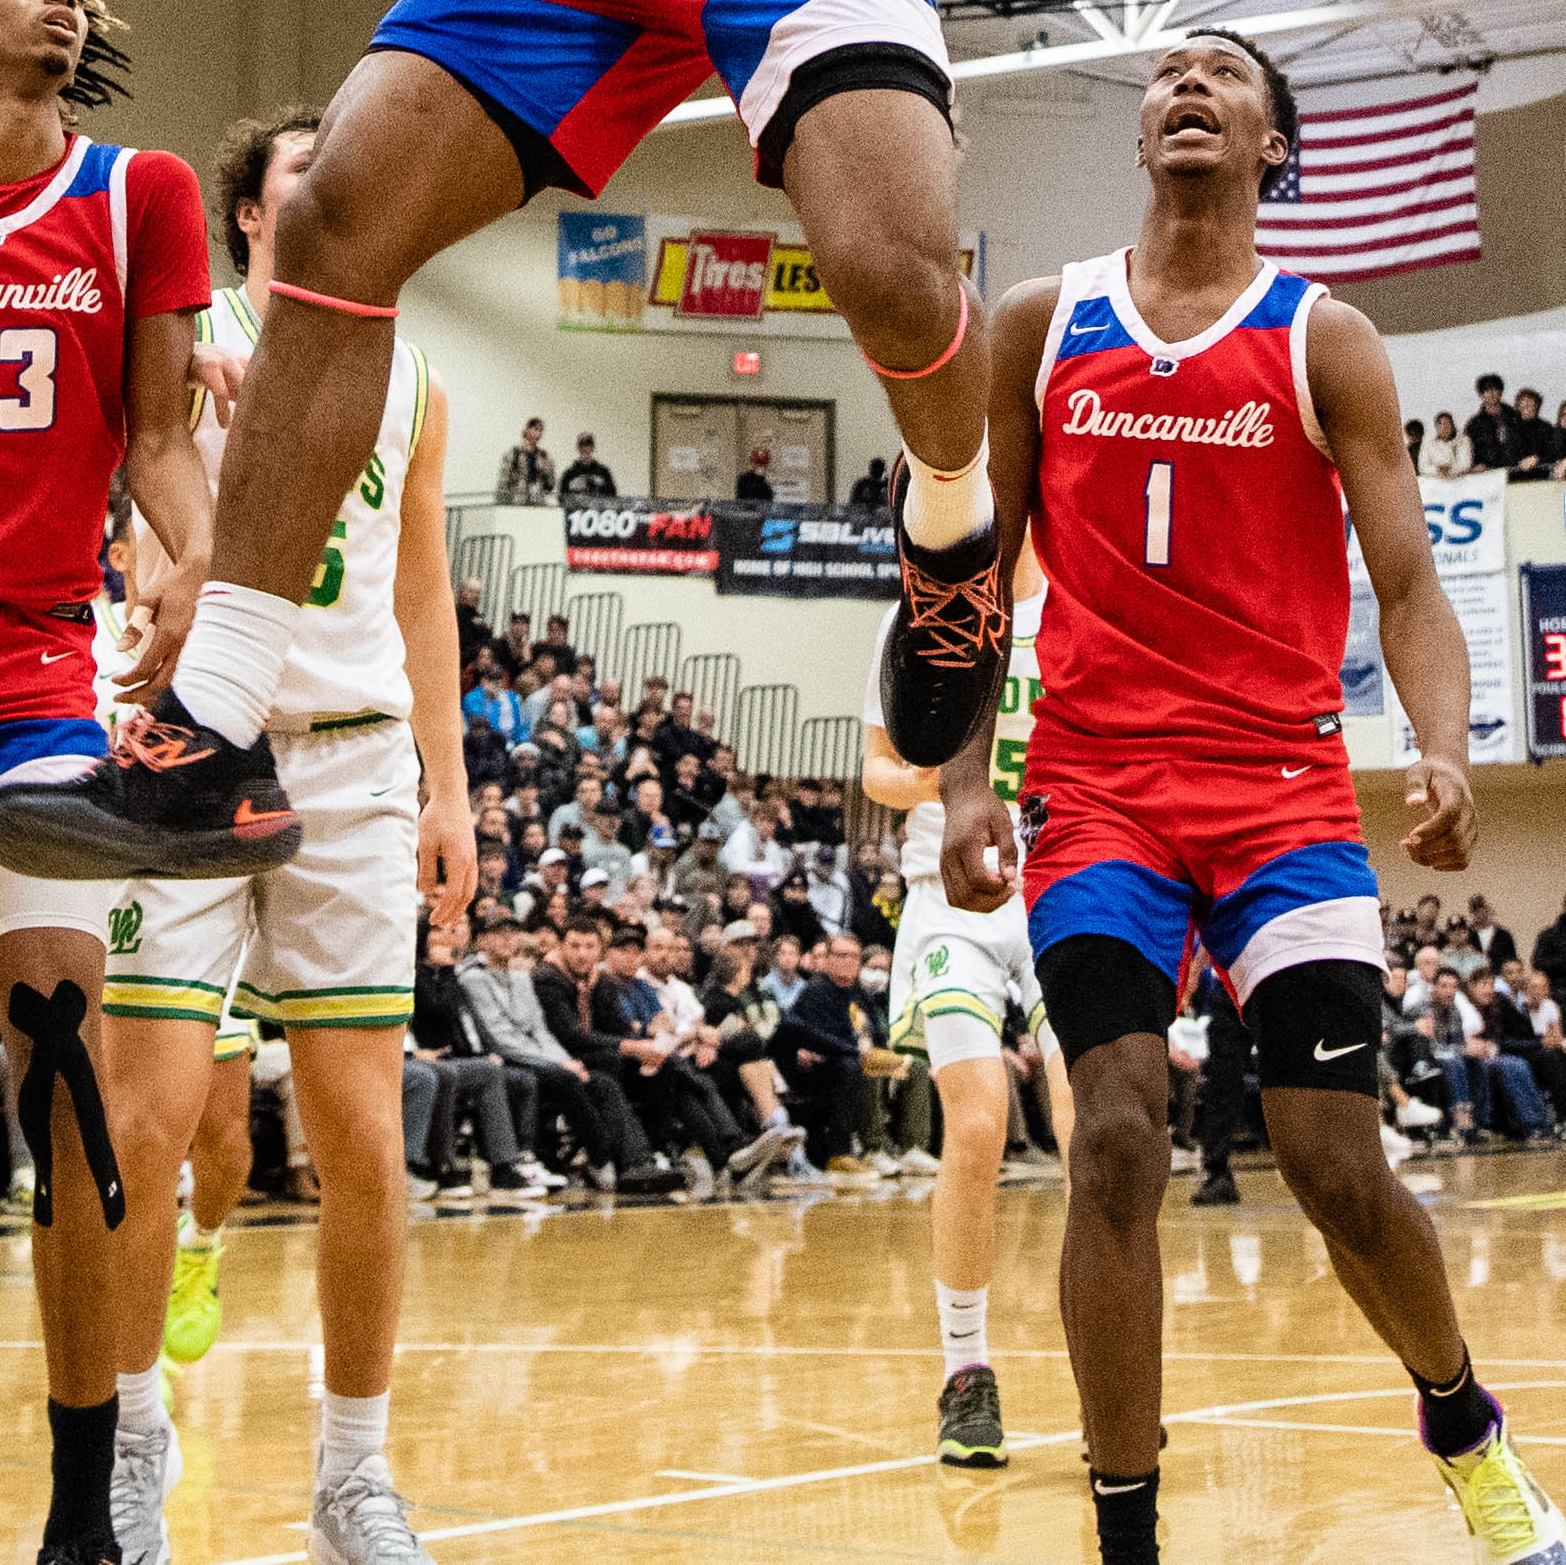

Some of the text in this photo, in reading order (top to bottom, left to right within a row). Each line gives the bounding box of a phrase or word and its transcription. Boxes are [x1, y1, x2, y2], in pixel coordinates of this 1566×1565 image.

[689, 243, 765, 295] Tires
[773, 263, 820, 293] LES
[1062, 389, 1275, 448] Duncanville
[568, 509, 637, 538] 1080
[1144, 459, 1174, 567] 1
